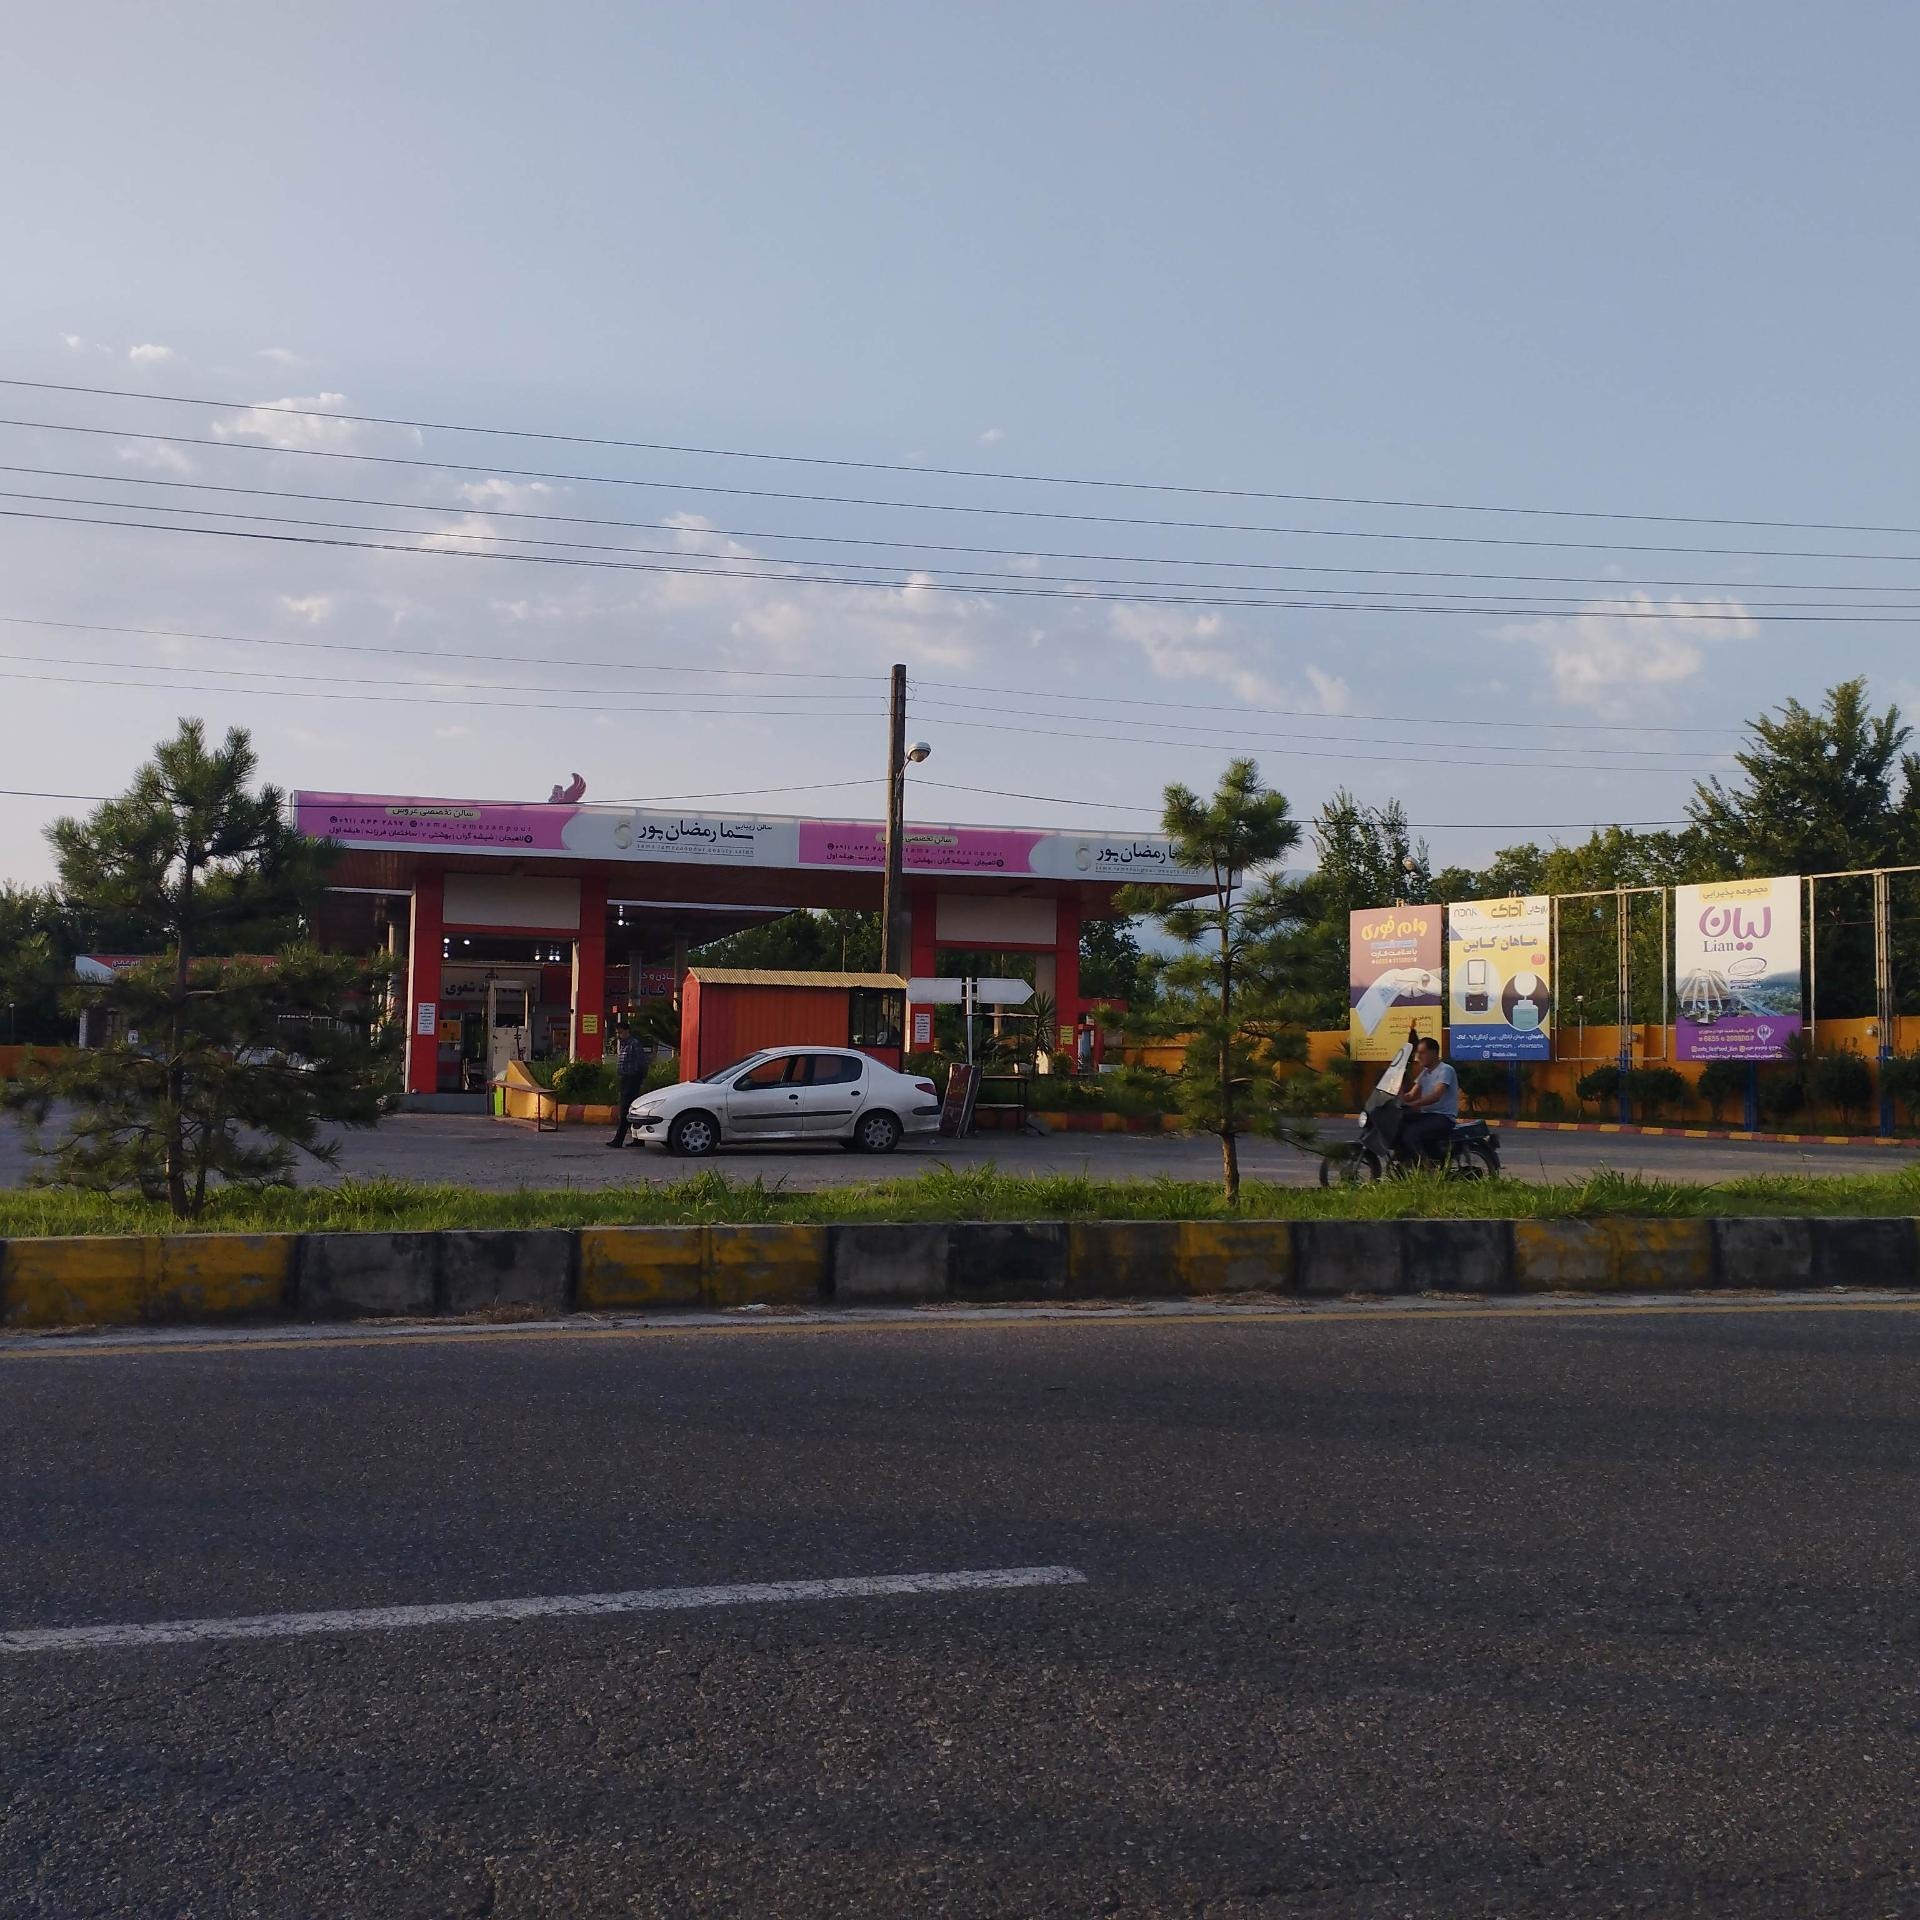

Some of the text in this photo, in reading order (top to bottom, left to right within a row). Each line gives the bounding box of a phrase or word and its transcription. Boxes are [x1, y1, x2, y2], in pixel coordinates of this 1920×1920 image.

[453, 809, 474, 819] سالن
[637, 824, 664, 841] پور
[665, 819, 717, 843] رمضان
[1096, 847, 1119, 862] پور
[1120, 842, 1165, 864] رمضان
[1702, 886, 1769, 900] مجموعه پذیرایی
[1360, 914, 1428, 941] وام فوری
[1699, 905, 1772, 951] لیان
[1463, 934, 1538, 953] ماهان کابین
[1703, 940, 1734, 953] Lian
